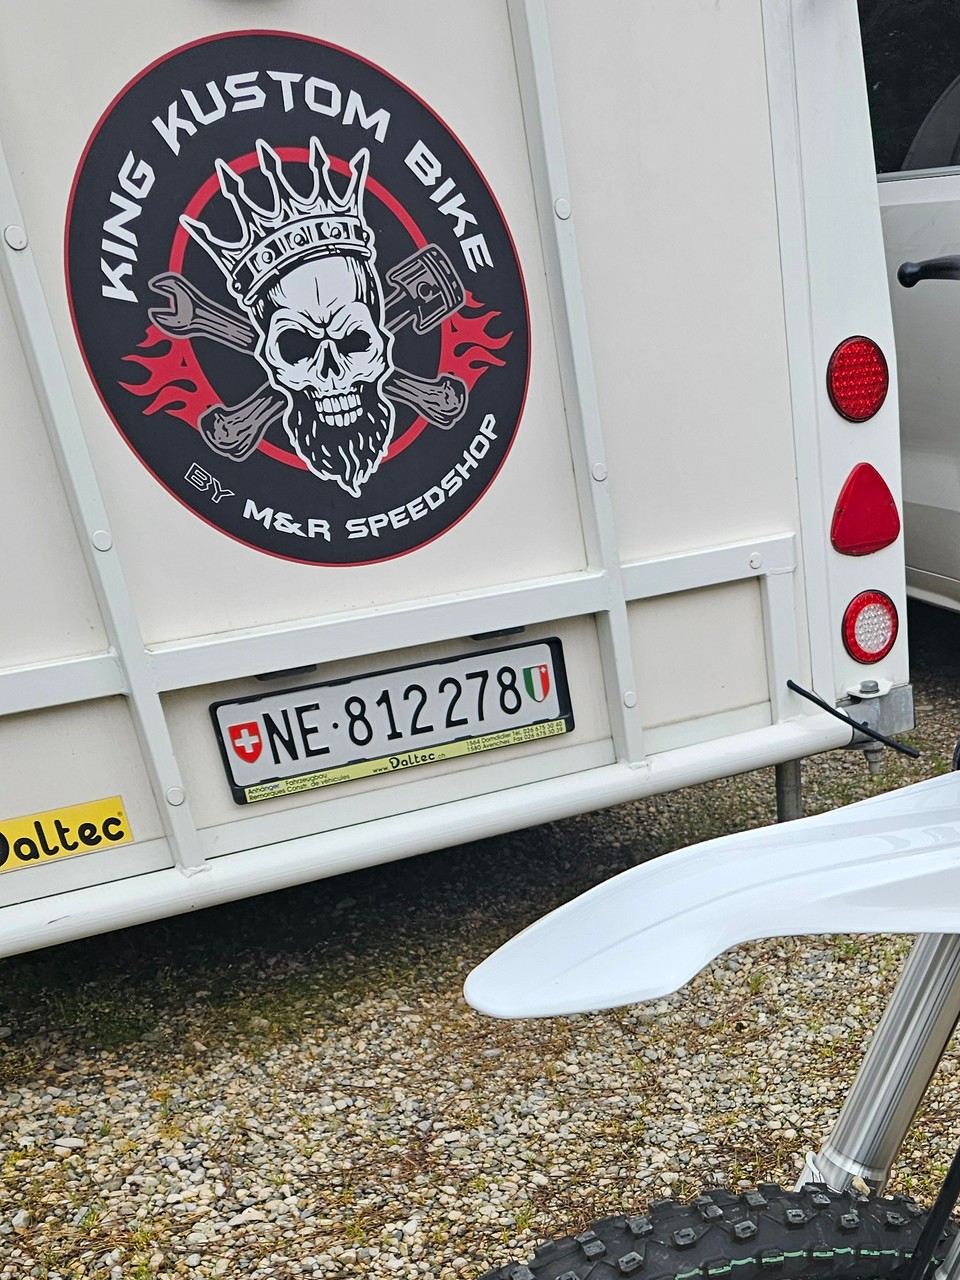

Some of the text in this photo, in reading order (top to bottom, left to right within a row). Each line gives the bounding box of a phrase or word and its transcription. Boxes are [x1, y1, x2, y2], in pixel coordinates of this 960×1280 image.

[101, 70, 495, 303] KING KUSTOM BIKE
[184, 412, 499, 542] BY M&R SPEEDSHOP
[0, 817, 124, 867] altec
